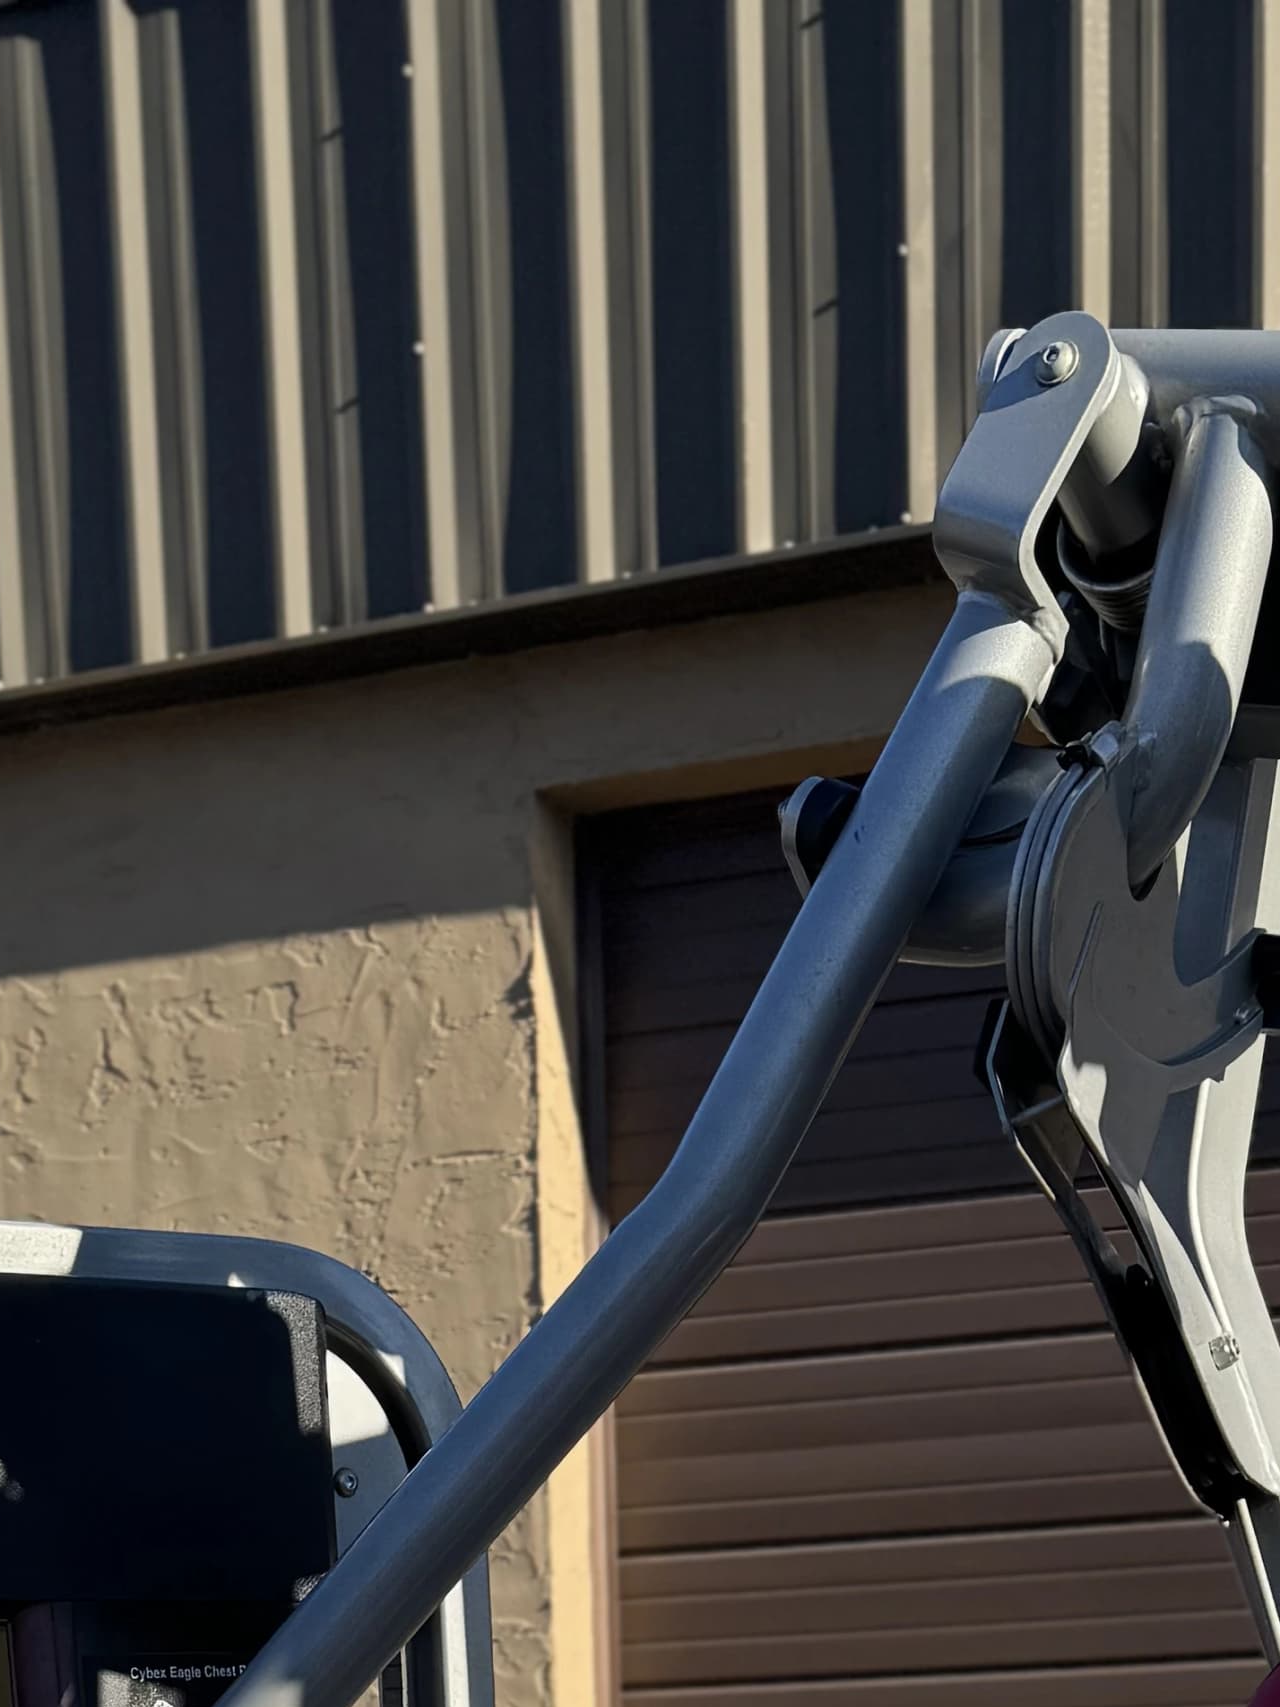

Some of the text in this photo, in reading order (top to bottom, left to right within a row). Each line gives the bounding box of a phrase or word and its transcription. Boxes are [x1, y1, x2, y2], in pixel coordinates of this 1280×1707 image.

[130, 1667, 167, 1682] Cybex
[170, 1666, 201, 1681] Eagle
[204, 1665, 236, 1677] Chest
